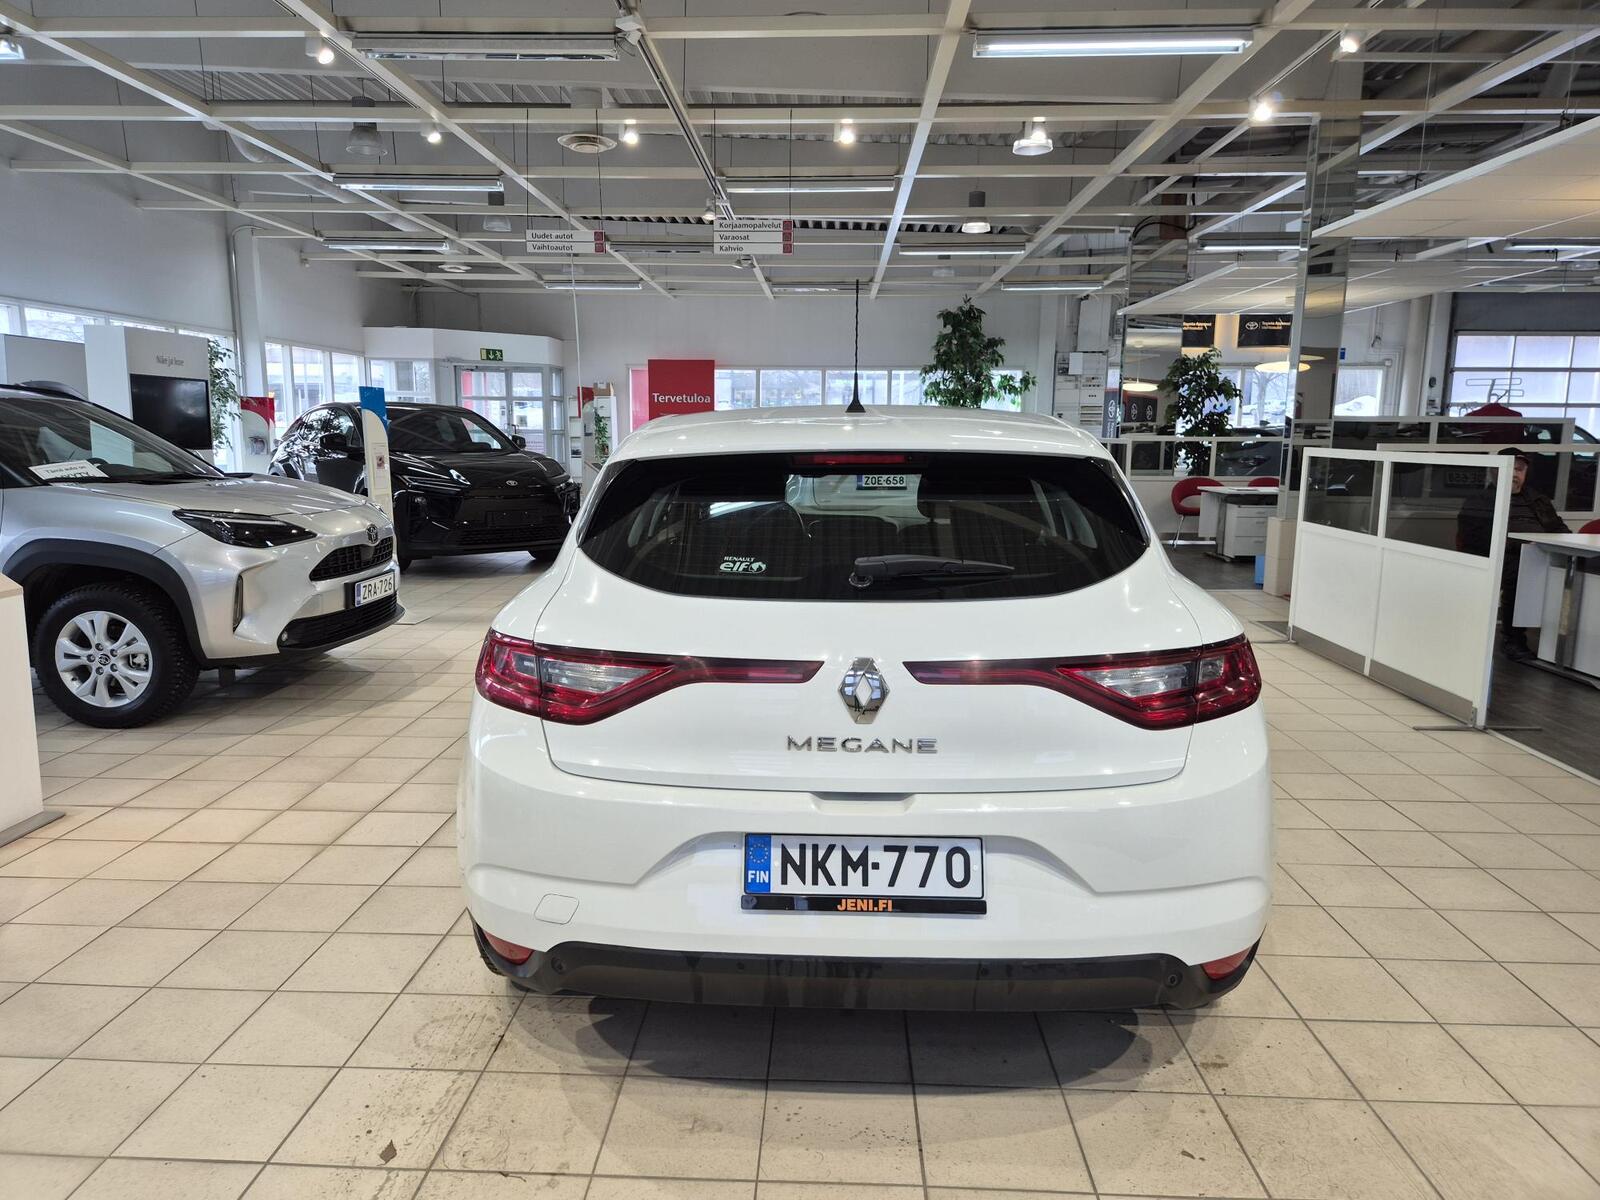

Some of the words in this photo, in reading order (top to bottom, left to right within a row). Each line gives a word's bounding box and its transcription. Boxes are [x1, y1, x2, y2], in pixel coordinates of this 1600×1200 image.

[719, 221, 782, 230] Korjaamopalvelut
[531, 232, 554, 240] Uudet
[555, 232, 574, 240] autot
[719, 233, 750, 241] Varaosat
[532, 243, 574, 251] Vaihtoautot
[653, 393, 710, 403] Tervetuloa
[864, 476, 904, 486] ZOE-658
[719, 561, 750, 572] elf
[362, 577, 393, 600] ZRA-726
[787, 736, 938, 754] MEGANE
[780, 842, 971, 889] NKM-770
[747, 870, 769, 883] FIN
[837, 898, 893, 912] JENI.FI
